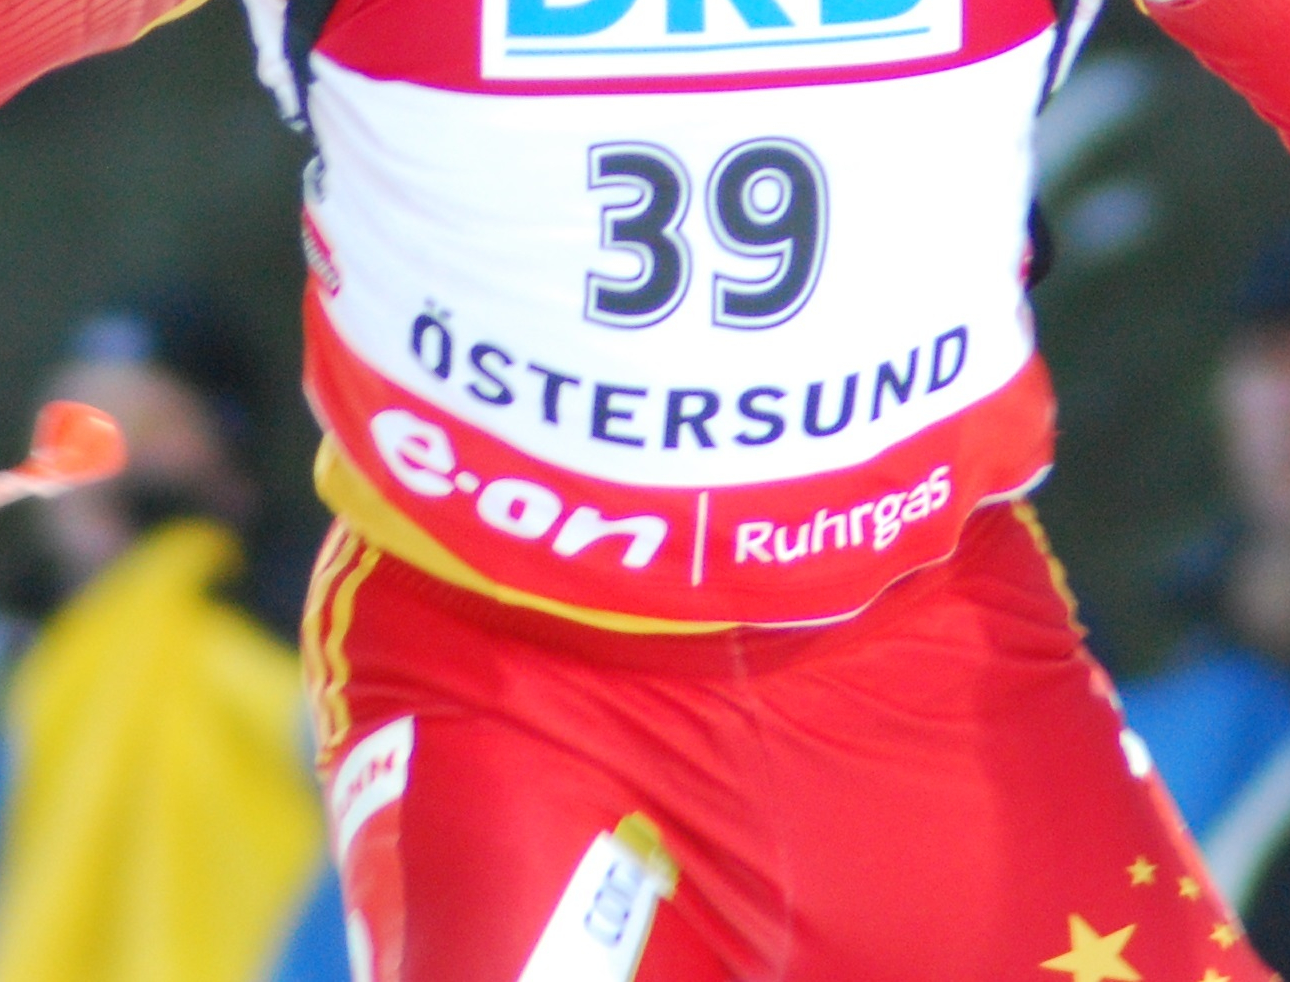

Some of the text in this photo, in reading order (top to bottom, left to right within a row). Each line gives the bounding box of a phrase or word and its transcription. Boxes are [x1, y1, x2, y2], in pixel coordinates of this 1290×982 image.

[583, 135, 830, 330] 39
[408, 297, 970, 452] ÖSTERSUND
[734, 464, 952, 566] Ruhrgas
